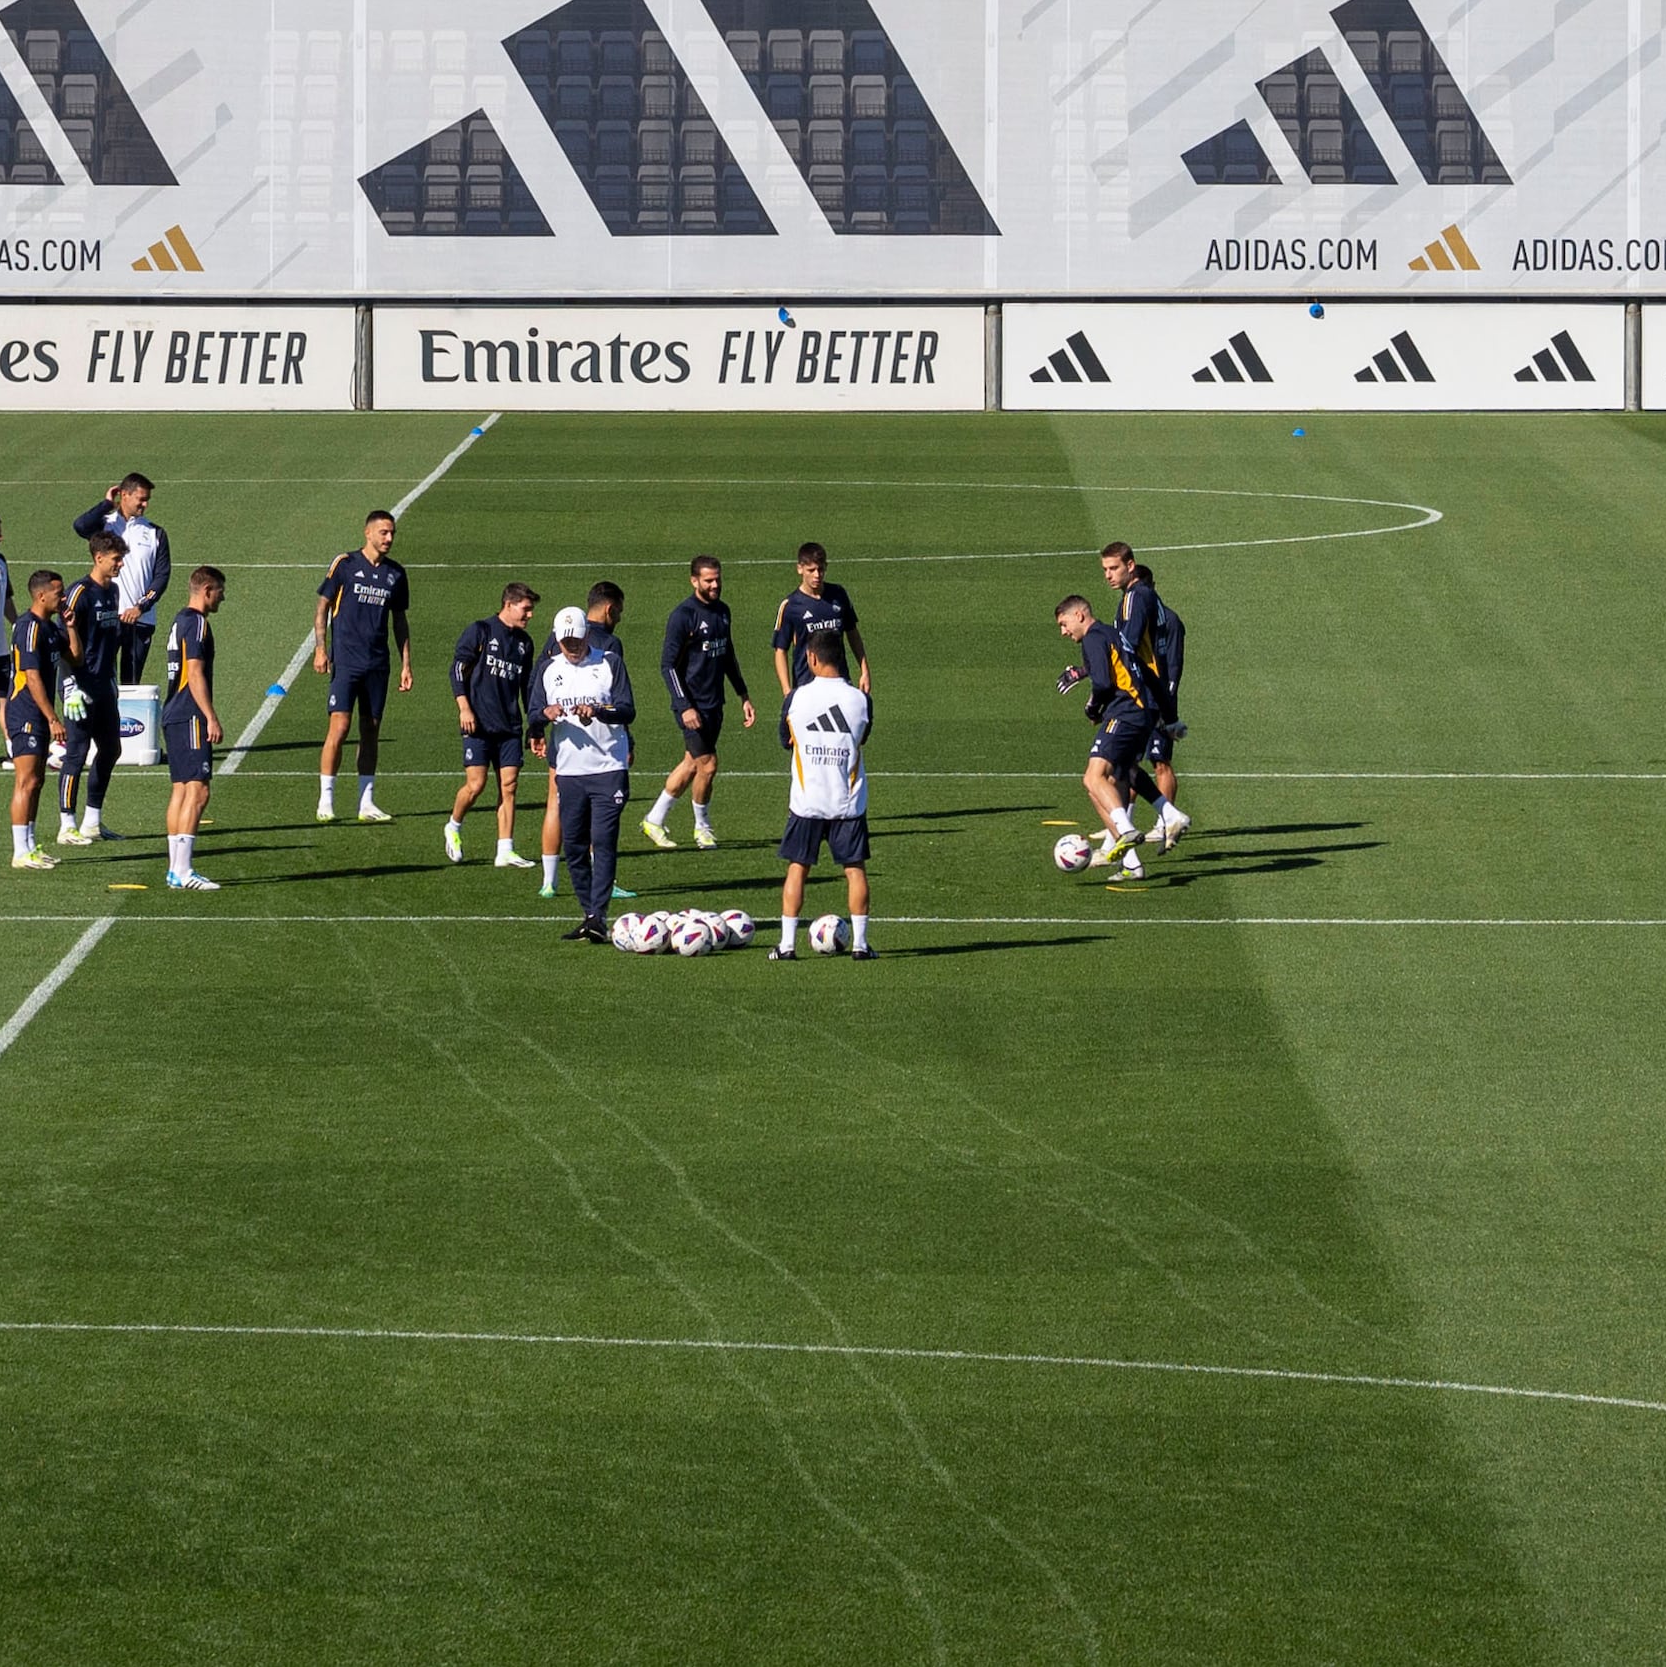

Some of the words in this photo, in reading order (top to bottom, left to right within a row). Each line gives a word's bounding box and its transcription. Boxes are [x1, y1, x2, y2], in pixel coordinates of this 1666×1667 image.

[1205, 239, 1378, 272] ADIDAS.COM
[88, 330, 155, 384] FLY
[167, 331, 308, 385] BETTER
[420, 327, 691, 384] Emirates
[720, 331, 785, 384] FLY
[797, 331, 939, 385] BETTER
